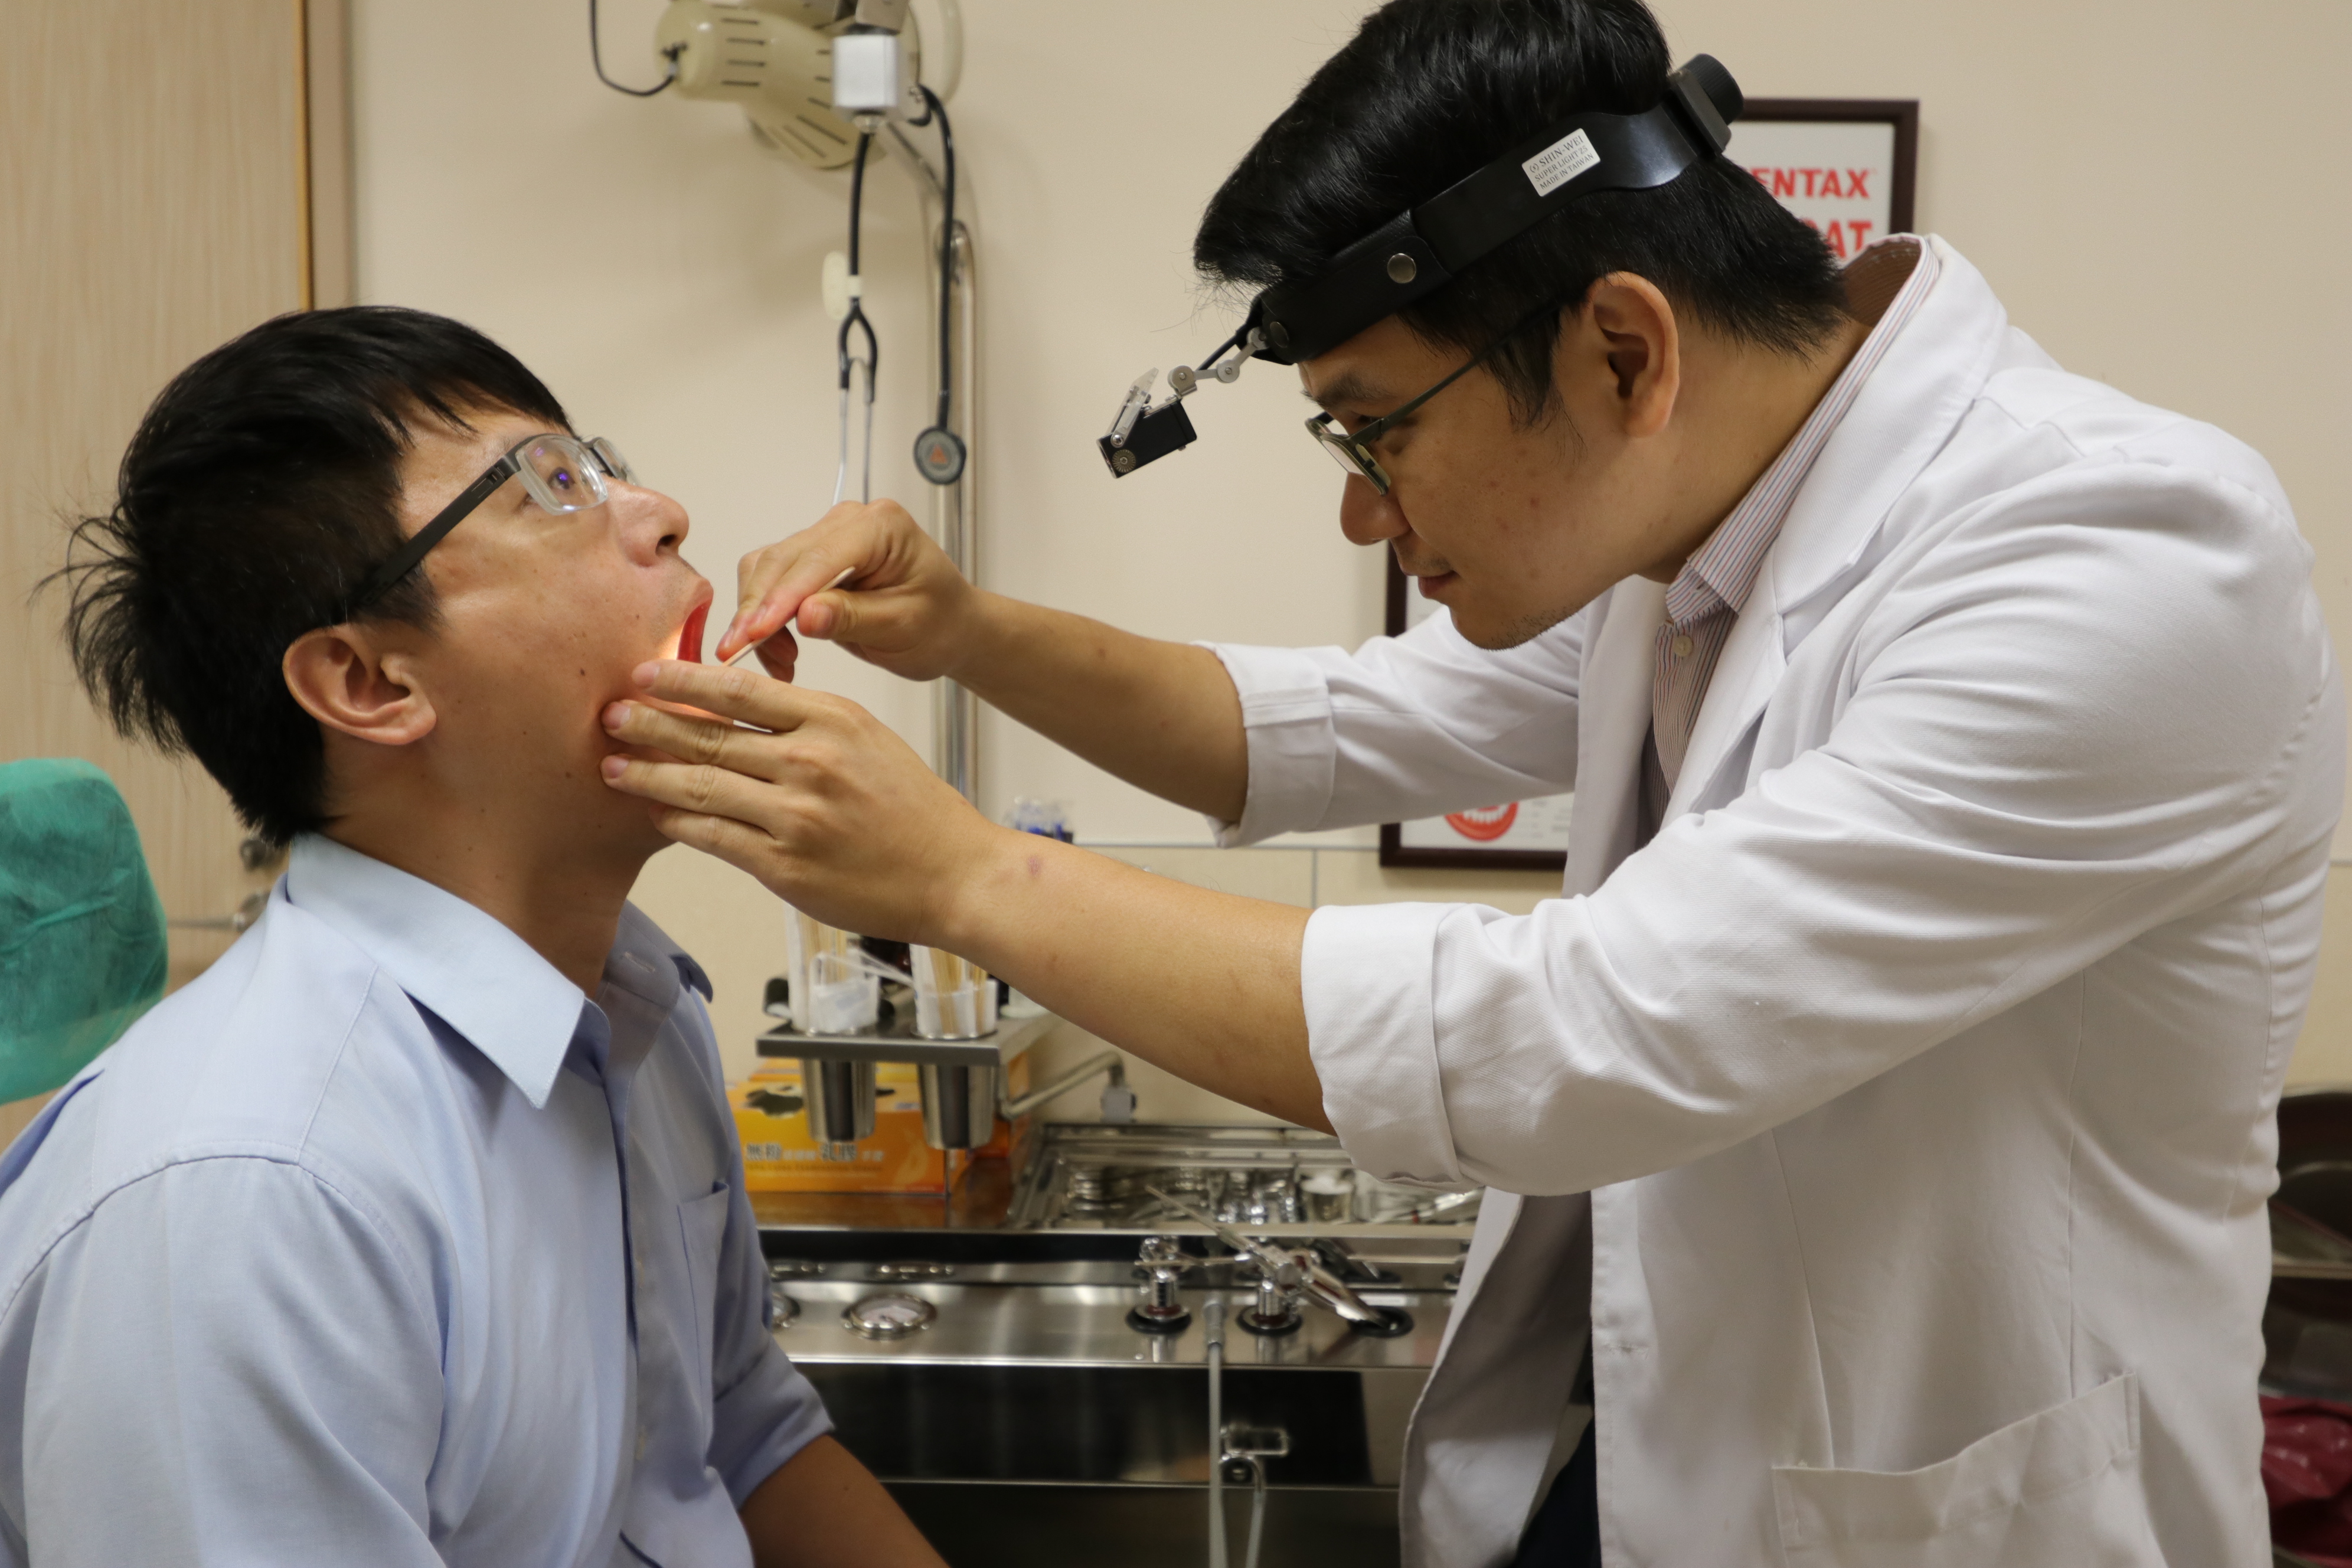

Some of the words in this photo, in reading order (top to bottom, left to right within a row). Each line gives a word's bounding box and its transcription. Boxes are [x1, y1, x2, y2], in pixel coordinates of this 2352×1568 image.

[1535, 164, 1558, 182] SUPER
[1557, 151, 1579, 167] LIGHT
[1539, 135, 1583, 166] SHIN-WEI
[1540, 174, 1560, 190] MADE
[1559, 168, 1568, 177] IN
[1567, 153, 1593, 172] TAIWAN
[1802, 219, 1872, 259] AT
